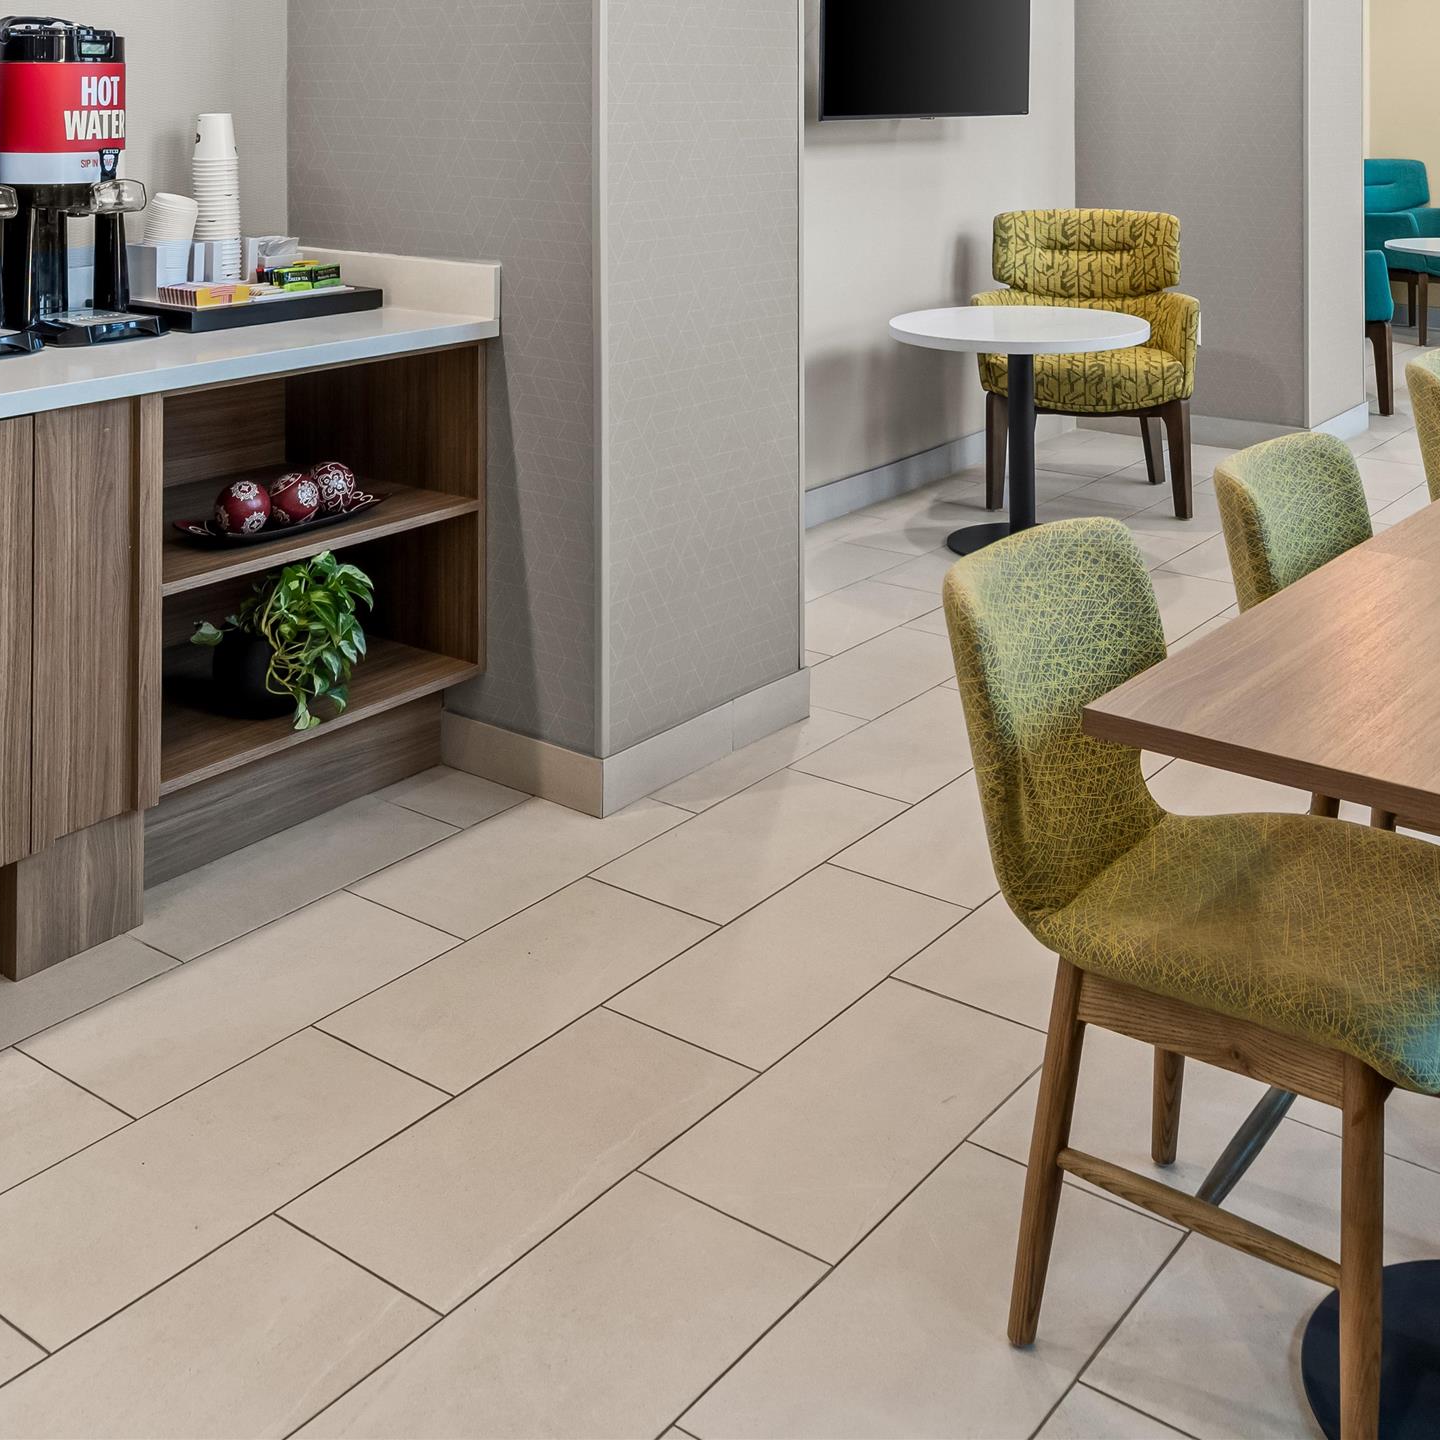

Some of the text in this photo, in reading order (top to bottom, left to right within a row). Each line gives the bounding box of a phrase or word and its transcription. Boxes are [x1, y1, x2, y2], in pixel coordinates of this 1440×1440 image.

[81, 76, 120, 106] HOT
[63, 109, 125, 140] WATER
[80, 159, 91, 168] SIP
